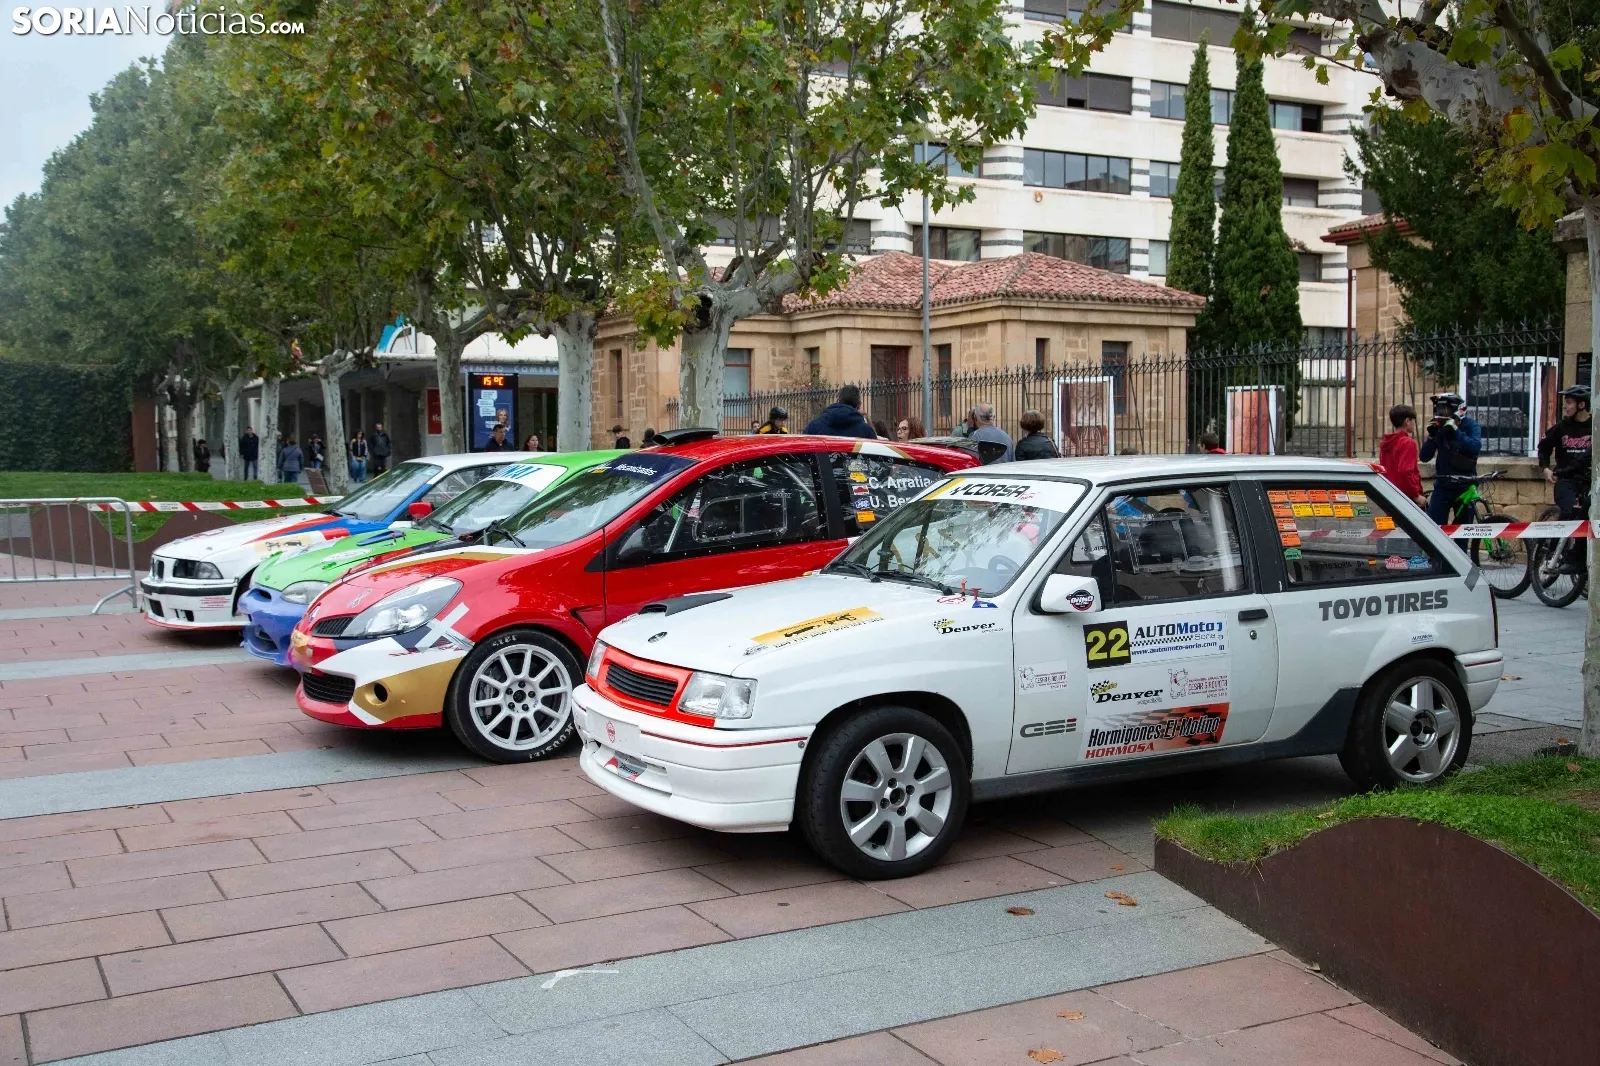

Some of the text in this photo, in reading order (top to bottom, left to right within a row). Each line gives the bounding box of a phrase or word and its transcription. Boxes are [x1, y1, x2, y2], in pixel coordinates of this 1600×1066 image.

[463, 365, 504, 373] CENTRO
[483, 376, 492, 386] 15
[868, 475, 931, 489] C. Arratia
[870, 495, 885, 508] U.
[1319, 589, 1449, 621] TOYO TIRES
[941, 622, 996, 635] Denver
[1086, 627, 1130, 661] 22
[1096, 689, 1163, 704] Denver
[1087, 714, 1221, 748] Hormigones El Molino
[1085, 742, 1155, 759] HORMOSA
